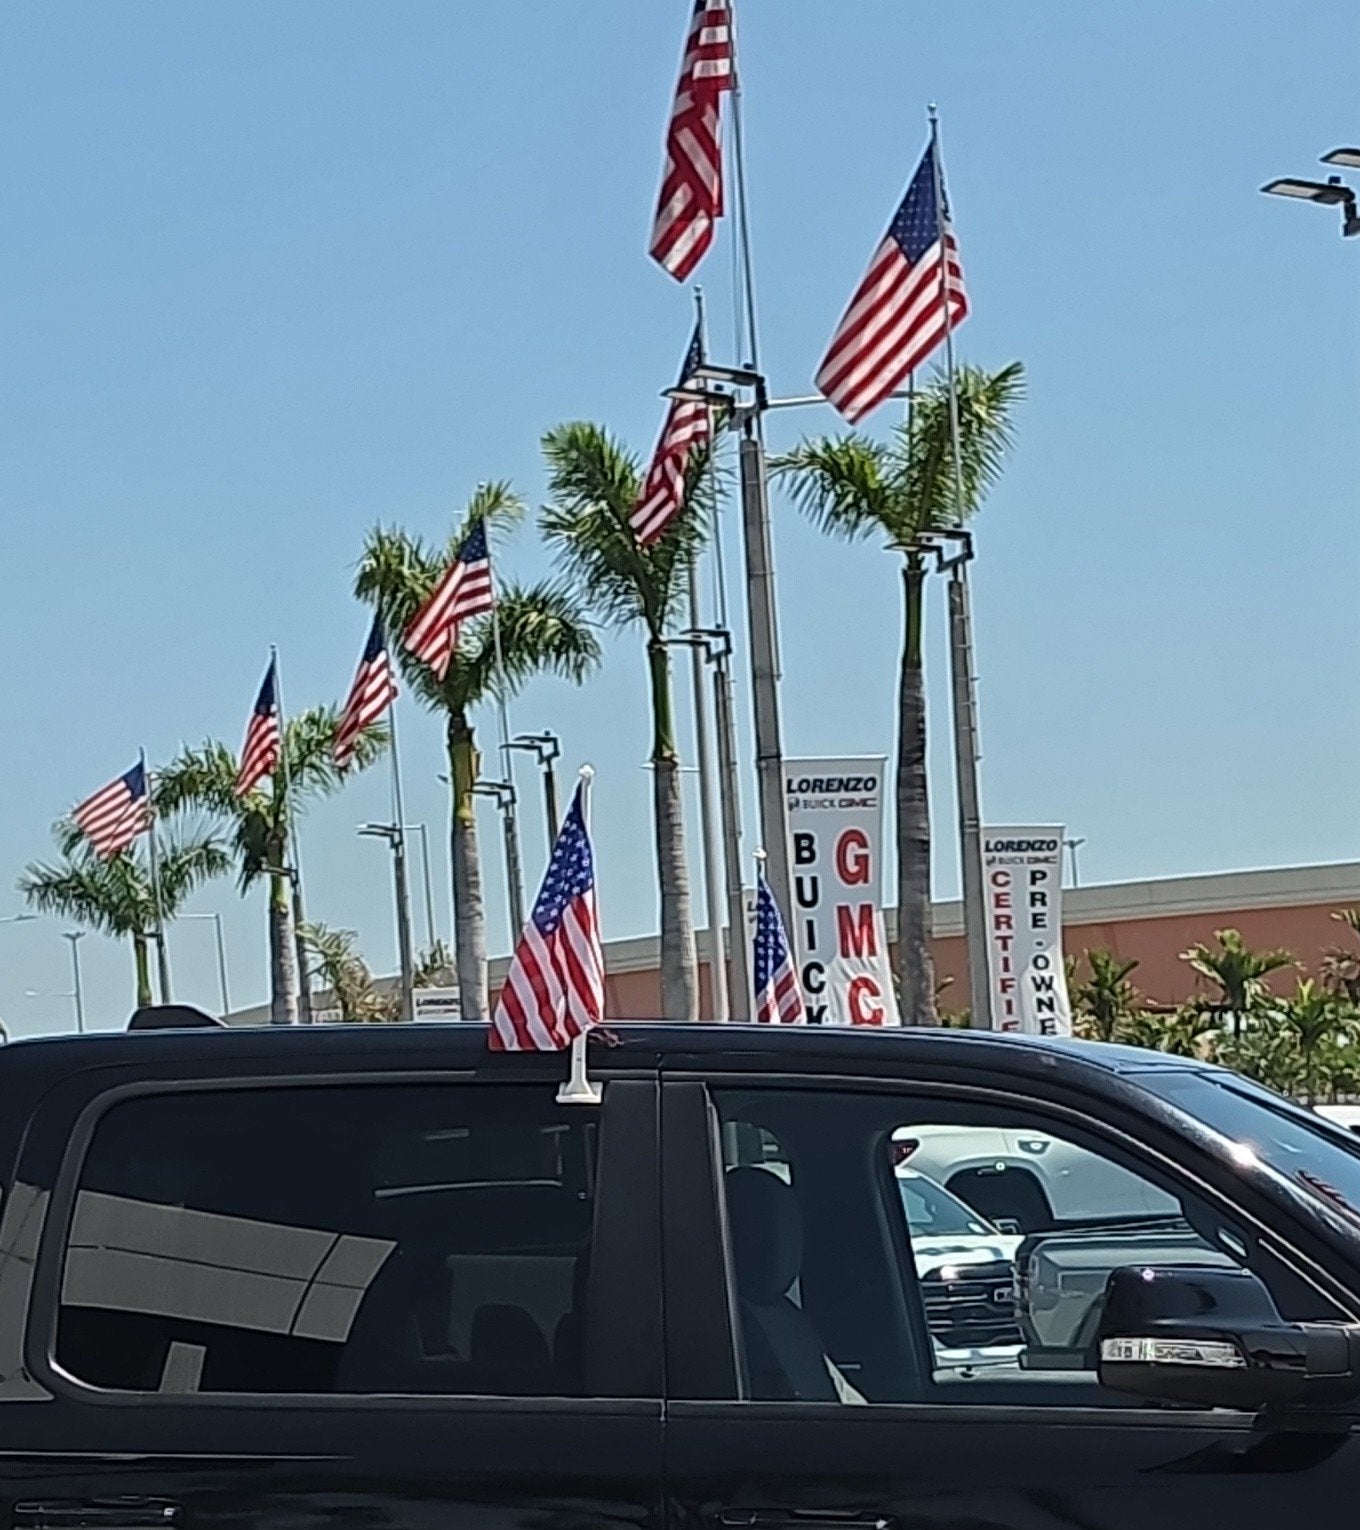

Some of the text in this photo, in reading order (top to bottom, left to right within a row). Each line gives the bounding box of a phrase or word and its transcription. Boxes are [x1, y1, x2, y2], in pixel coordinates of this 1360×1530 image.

[786, 776, 877, 794] LORENZO
[984, 839, 1058, 853] LORENZO
[835, 828, 884, 1026] GMC
